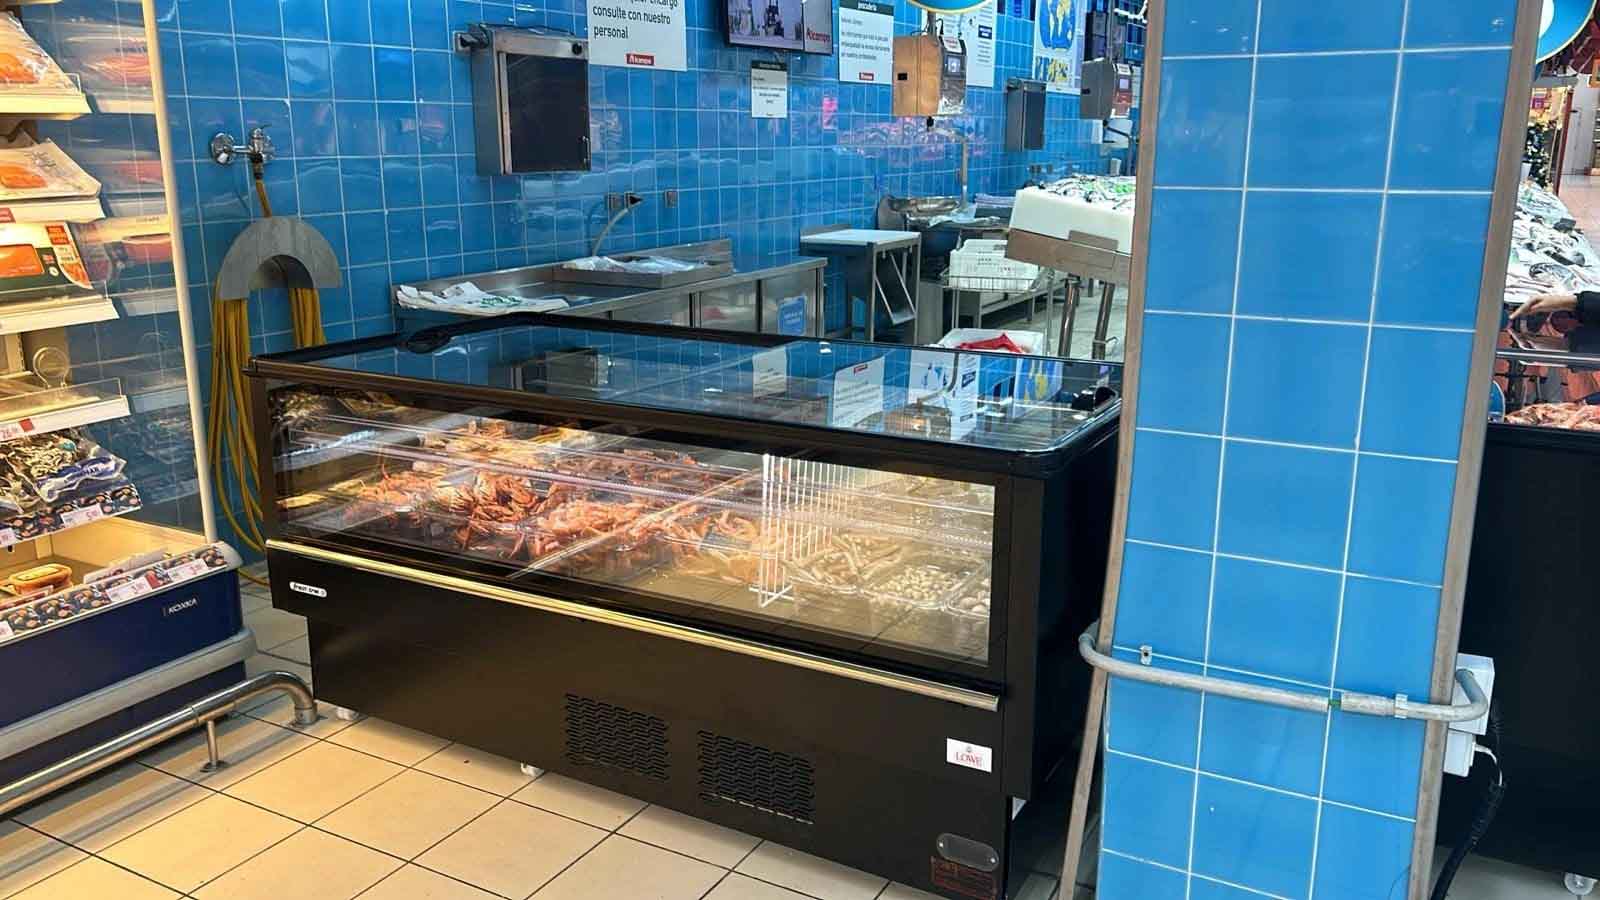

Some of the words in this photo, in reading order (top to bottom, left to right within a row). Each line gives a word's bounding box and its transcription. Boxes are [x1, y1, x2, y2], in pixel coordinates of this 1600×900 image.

[593, 6, 627, 20] consulte
[628, 10, 642, 22] con
[643, 13, 671, 25] nuestro
[594, 25, 629, 39] personal
